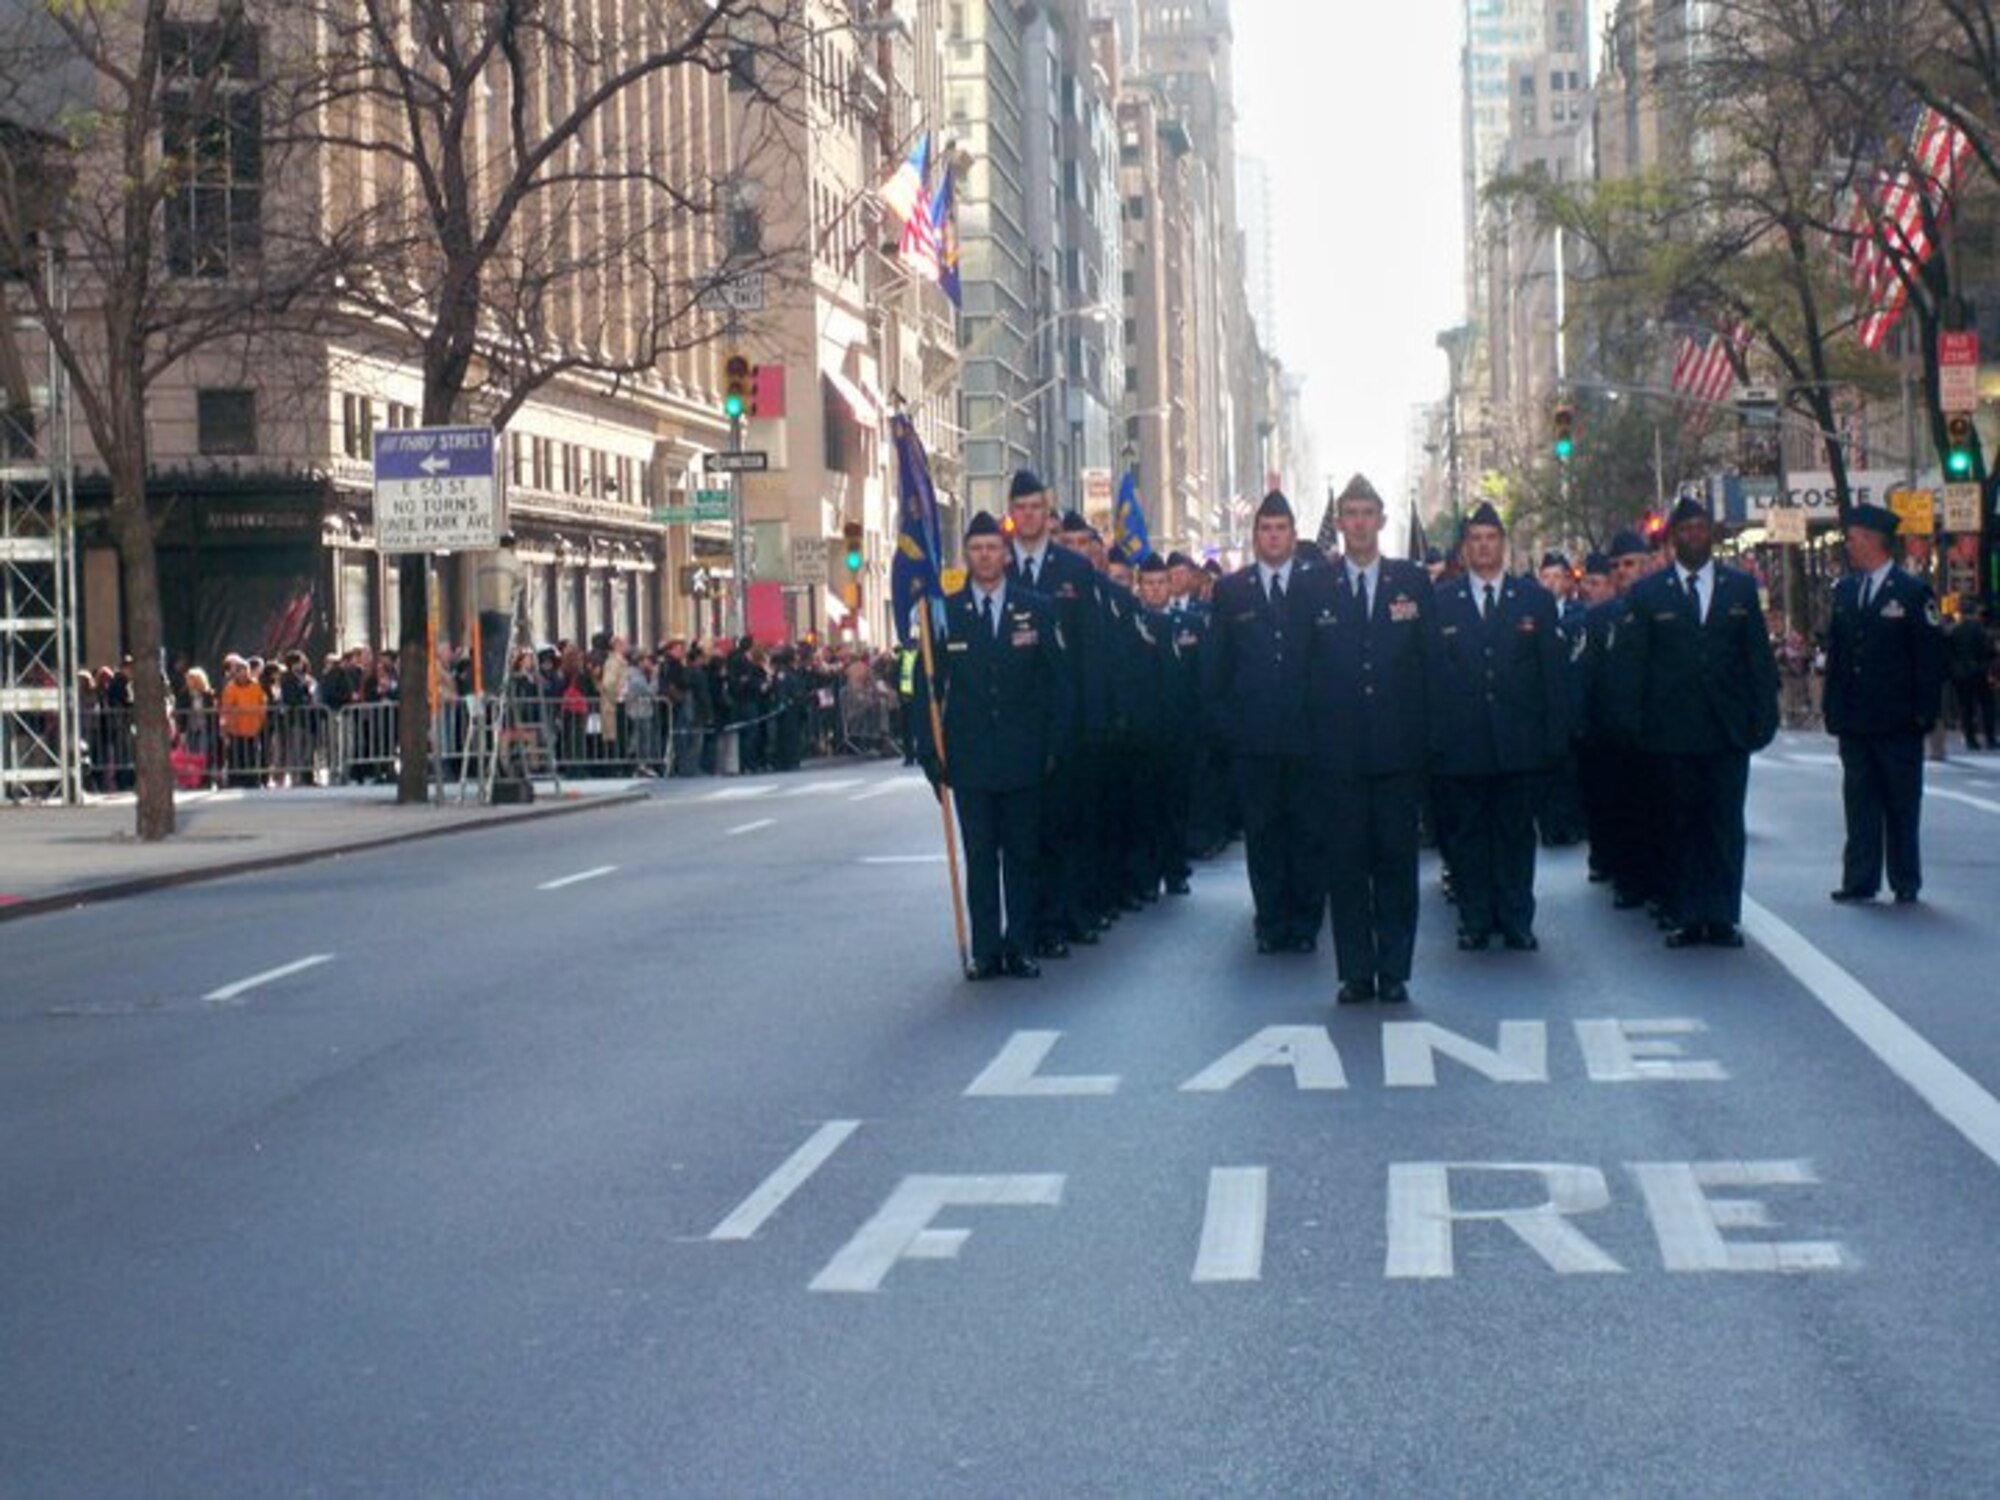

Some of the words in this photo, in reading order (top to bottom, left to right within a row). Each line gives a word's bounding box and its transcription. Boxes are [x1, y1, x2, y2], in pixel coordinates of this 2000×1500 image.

[439, 433, 488, 450] STREET
[402, 482, 409, 495] E
[420, 480, 442, 496] 50
[448, 479, 466, 493] ST
[393, 499, 416, 514] NO
[423, 496, 478, 513] TURNS
[424, 515, 459, 531] PARK
[466, 513, 490, 529] AVE
[962, 1018, 1730, 1097] LANE
[808, 1160, 1846, 1292] FIRE
